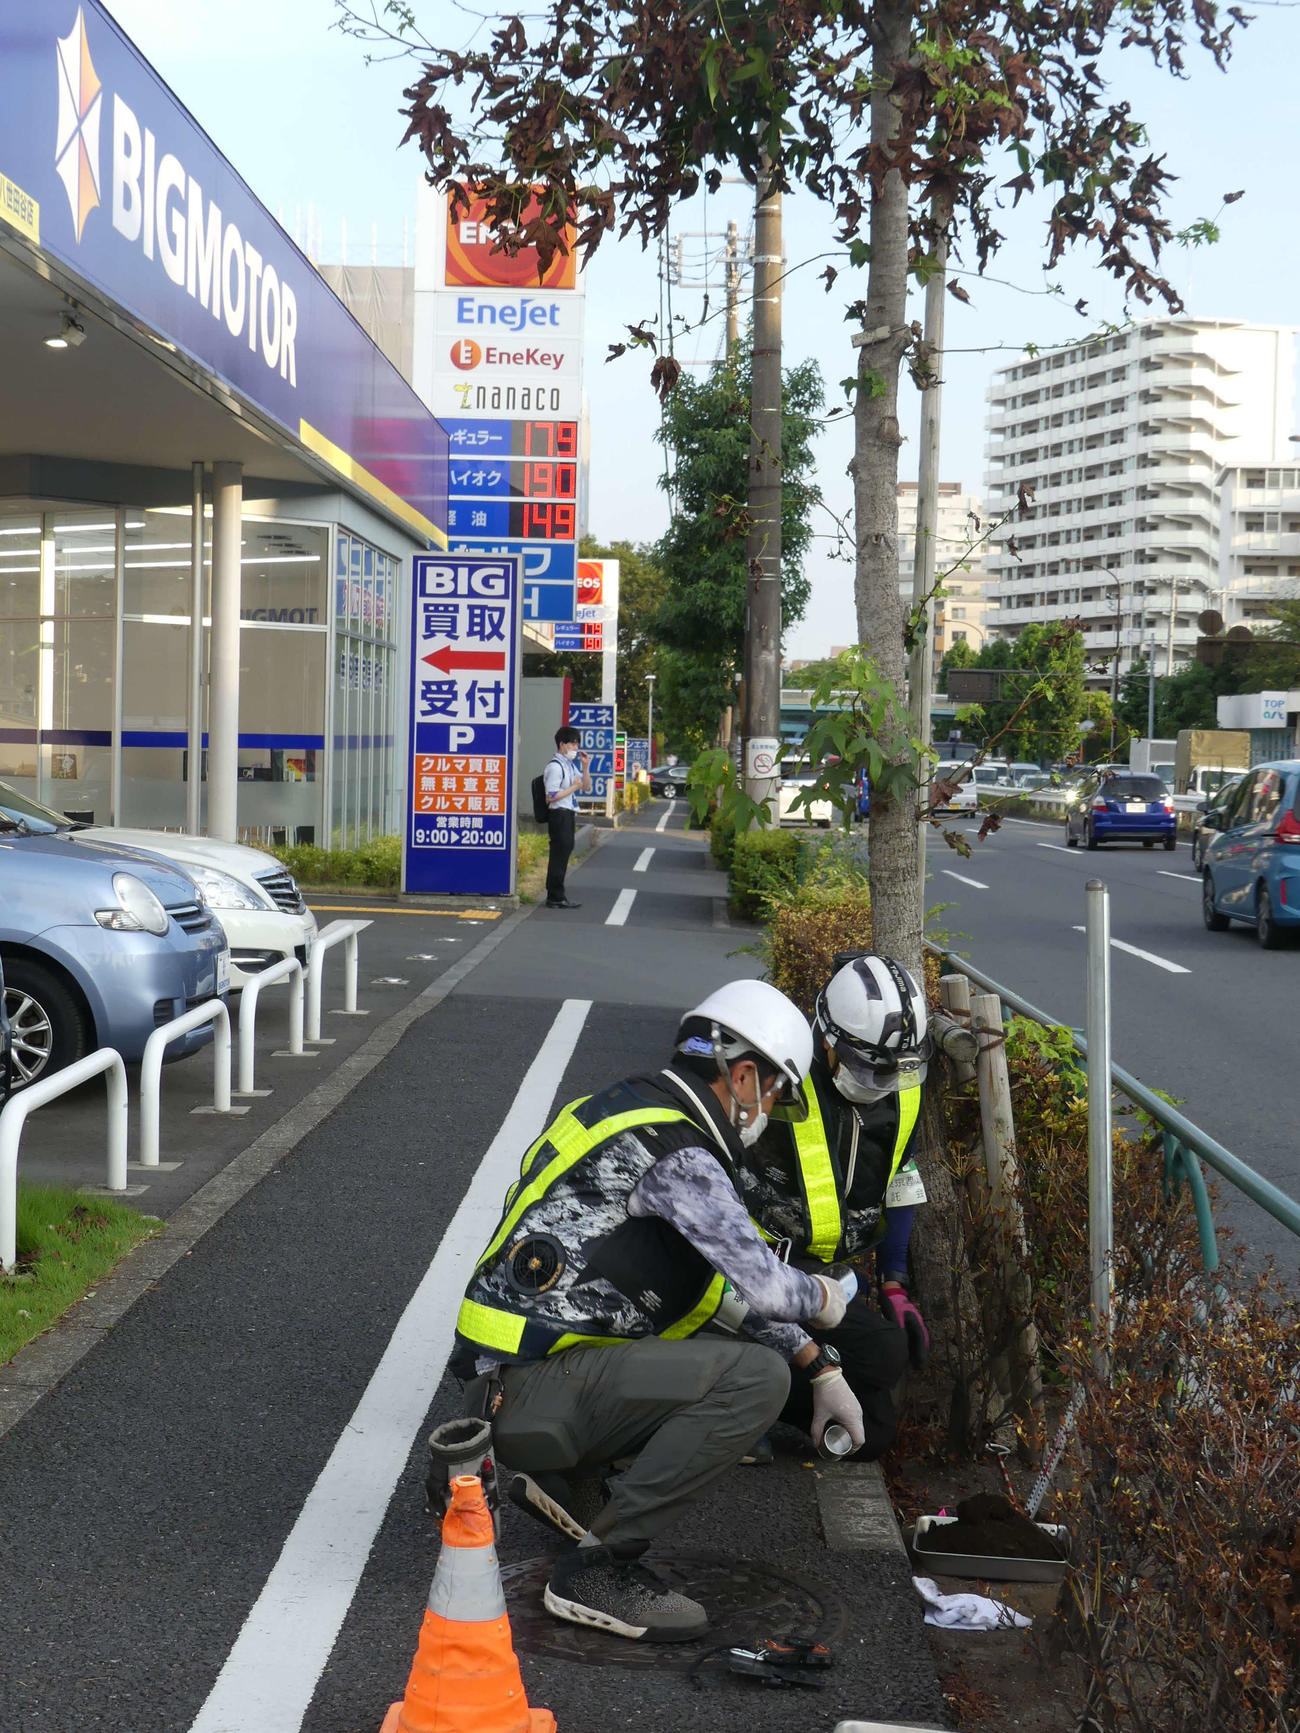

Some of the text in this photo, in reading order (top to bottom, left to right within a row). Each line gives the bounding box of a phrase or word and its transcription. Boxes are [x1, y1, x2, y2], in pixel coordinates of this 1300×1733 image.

[113, 92, 297, 388] BIGMOTOR
[457, 297, 560, 331] Enejet
[486, 347, 565, 370] EneKey
[476, 386, 560, 411] nanaco
[525, 421, 577, 458] 179
[524, 462, 576, 499] 190
[522, 503, 576, 540] 149
[425, 566, 506, 596] BIG
[421, 603, 506, 642] 買取
[584, 623, 603, 635] 179
[584, 637, 602, 650] 190
[419, 679, 506, 718] 受付
[1264, 699, 1285, 708] TOP
[450, 726, 474, 752] P
[580, 730, 606, 749] 166
[421, 756, 500, 773] クルマ買取
[421, 776, 500, 792] 無料査定
[420, 795, 500, 811] クルマ販売
[436, 816, 483, 829] 営業時間
[415, 829, 503, 845] 9:00 20:00
